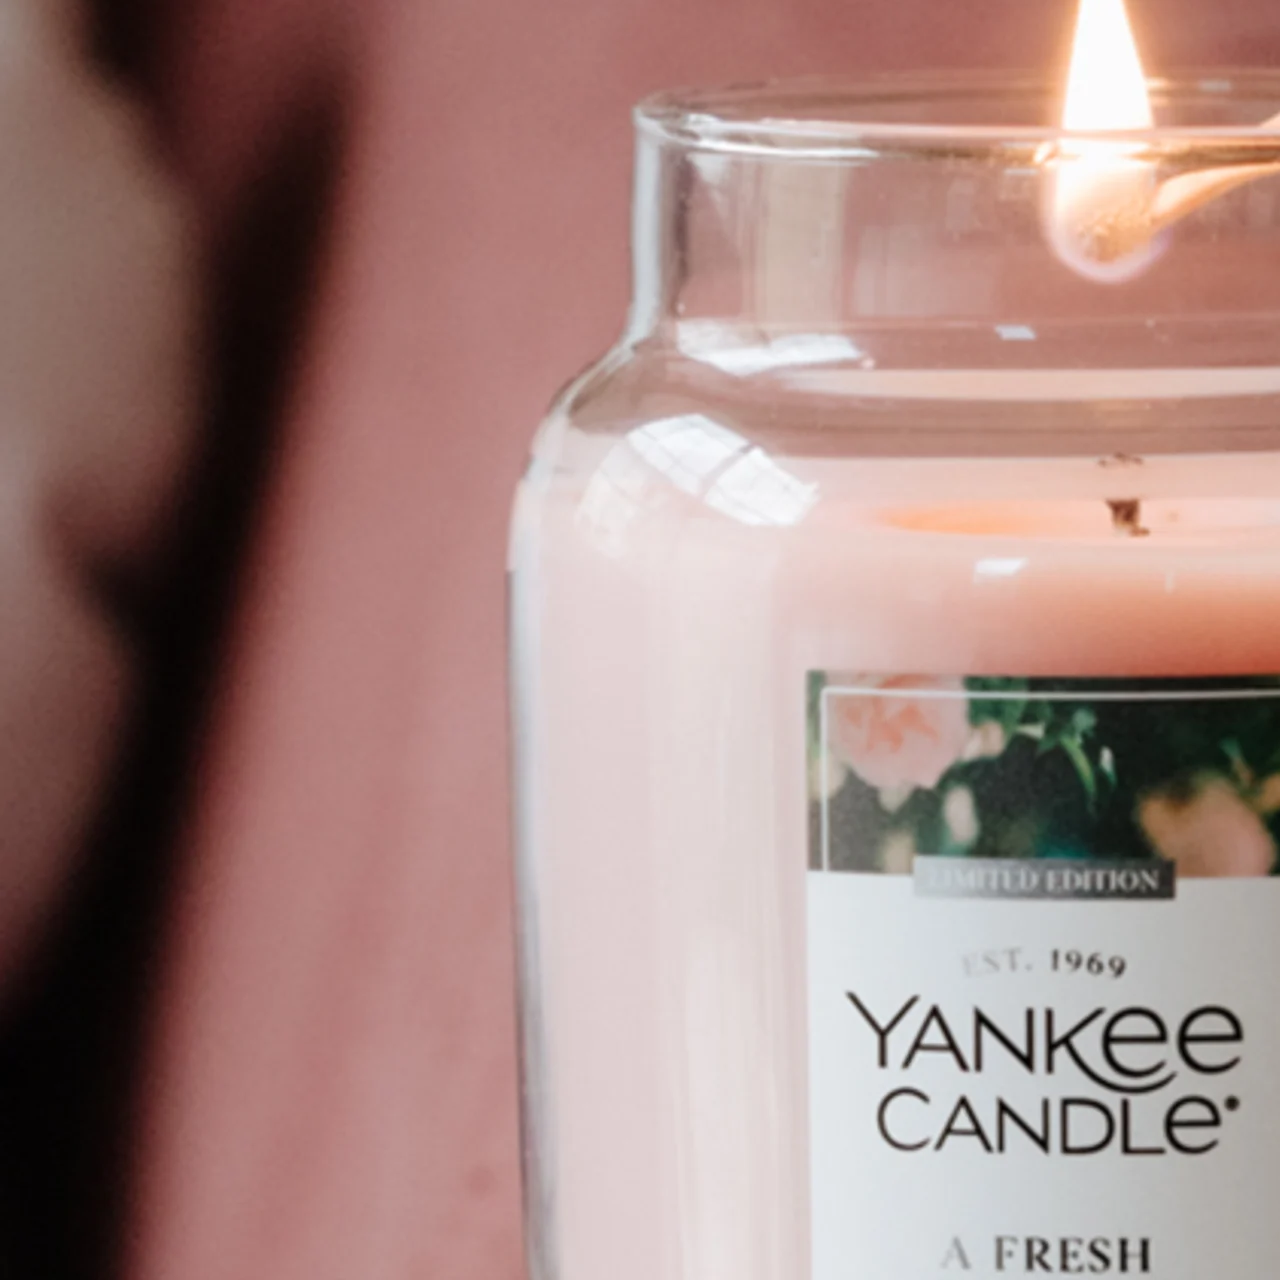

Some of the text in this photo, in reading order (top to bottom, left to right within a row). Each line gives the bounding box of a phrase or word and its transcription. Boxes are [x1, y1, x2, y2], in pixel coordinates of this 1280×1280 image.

[1045, 868, 1161, 894] EDITION
[1050, 948, 1127, 980] 1969
[940, 1235, 1153, 1275] A FRESH
